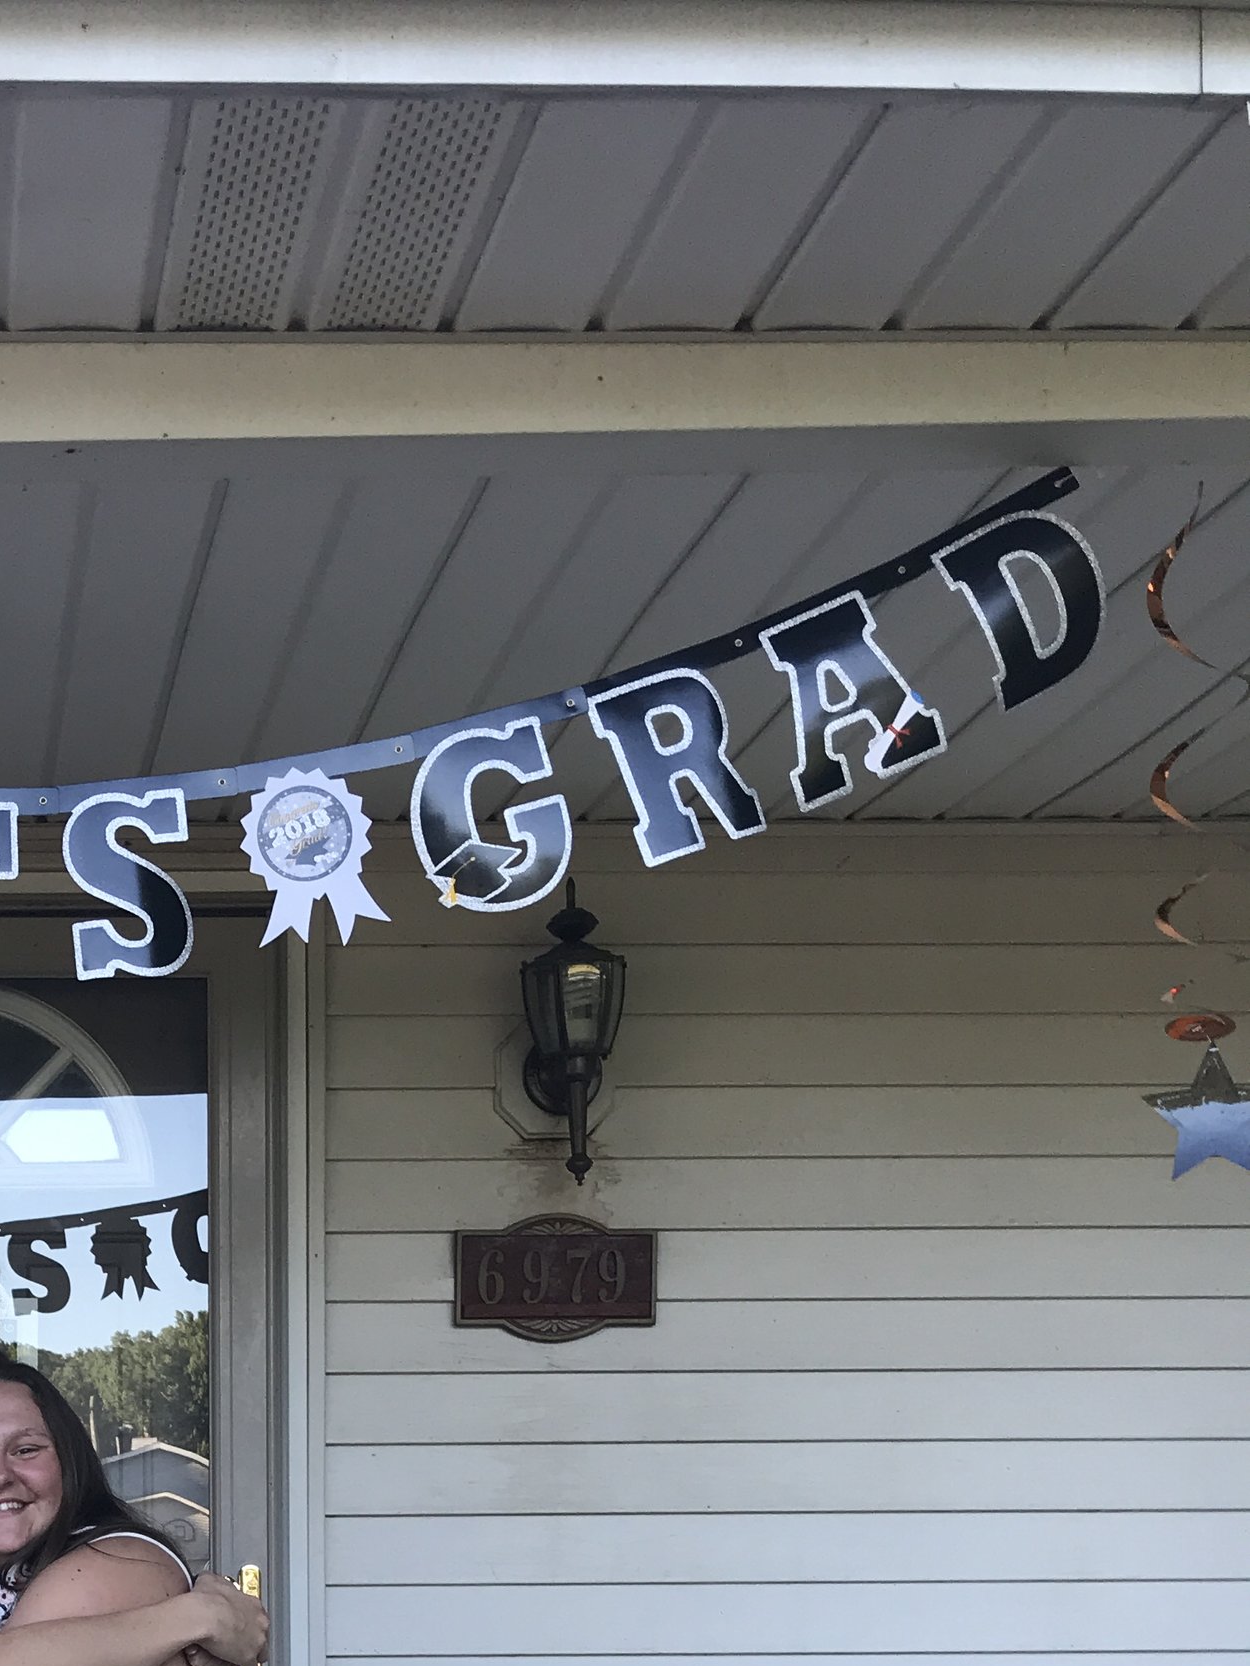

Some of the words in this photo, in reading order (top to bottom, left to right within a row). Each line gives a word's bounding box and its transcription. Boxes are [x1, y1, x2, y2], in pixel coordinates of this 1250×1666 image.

[412, 509, 1106, 912] GRAD
[268, 809, 330, 848] 2018
[477, 1250, 626, 1305] 6979
